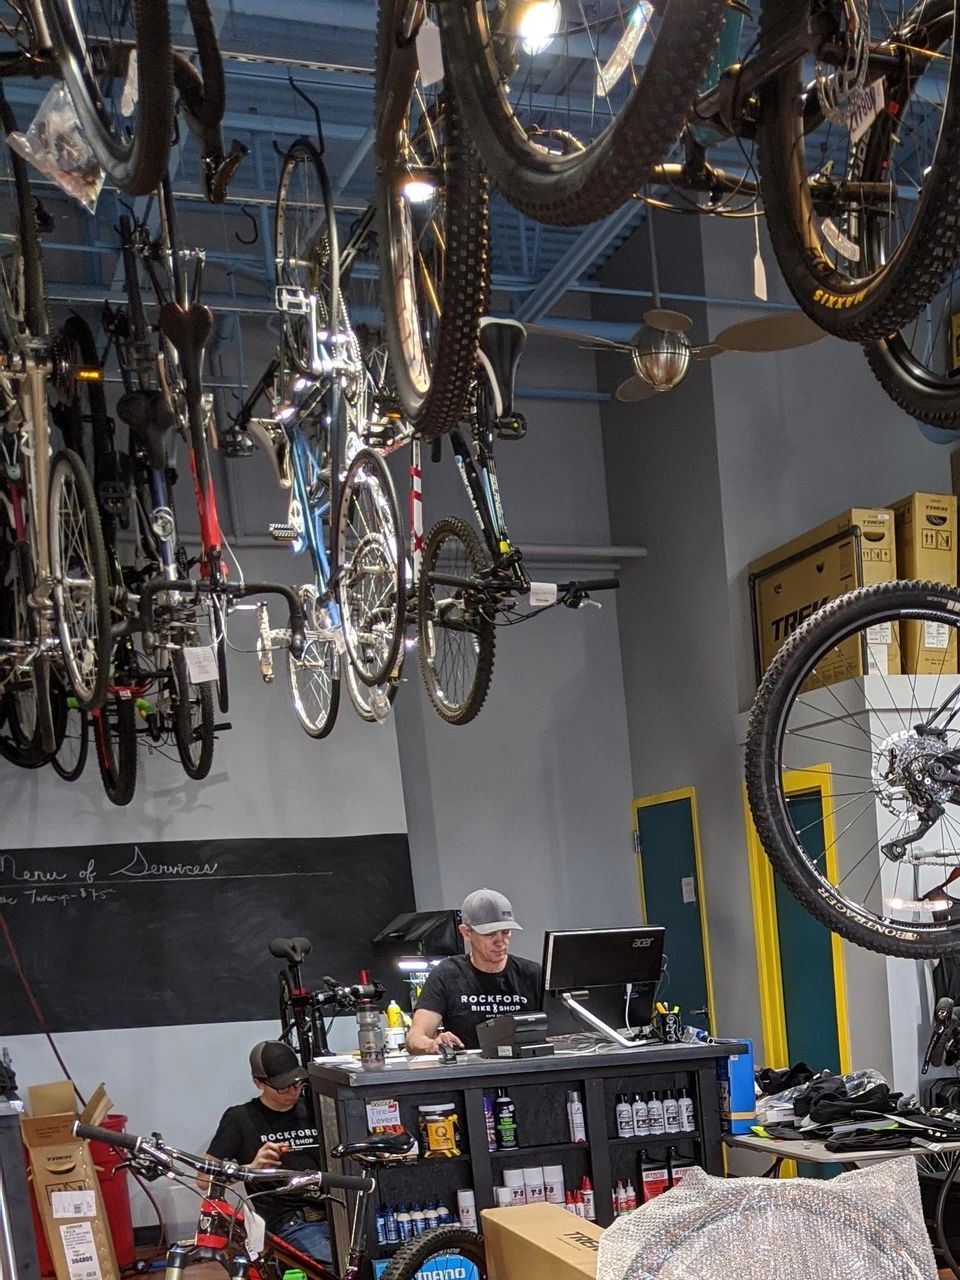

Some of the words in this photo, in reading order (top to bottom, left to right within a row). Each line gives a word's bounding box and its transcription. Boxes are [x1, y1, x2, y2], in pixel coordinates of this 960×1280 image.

[813, 288, 868, 309] MAXXIS
[79, 859, 97, 883] of
[109, 846, 218, 876] Services
[817, 887, 907, 940] BONTRAGER
[632, 938, 654, 948] acer
[461, 995, 528, 1004] ROCKFORD
[370, 1107, 387, 1116] Tire
[371, 1116, 399, 1125] Levers
[260, 1128, 318, 1142] ROCKFORD
[564, 1231, 600, 1251] TRE
